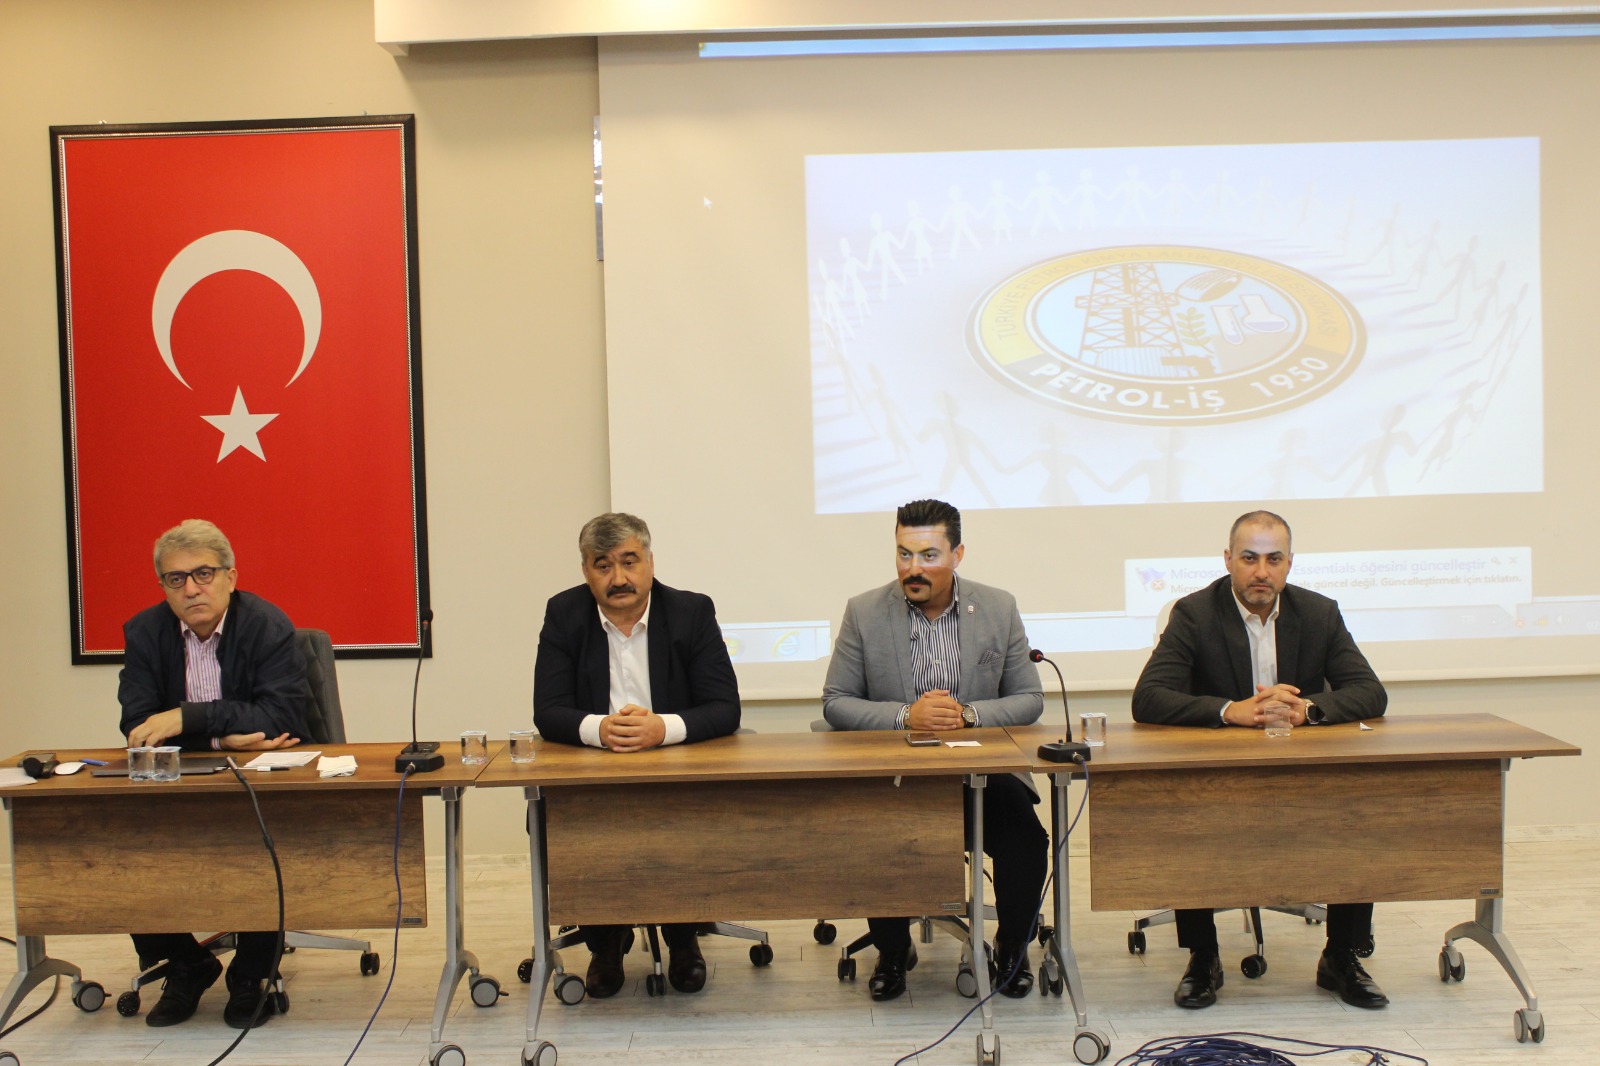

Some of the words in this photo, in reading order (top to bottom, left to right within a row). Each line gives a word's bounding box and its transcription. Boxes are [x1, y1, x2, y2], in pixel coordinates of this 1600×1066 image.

[1029, 363, 1225, 412] PETROL-İŞ
[1250, 357, 1329, 397] 1950
[1293, 561, 1356, 575] Essentials
[1359, 559, 1407, 576] öğesini
[1410, 557, 1487, 574] güncelleştir
[1314, 578, 1348, 590] güncel
[1351, 577, 1379, 589] değil.
[1381, 575, 1462, 588] Güncelleştirmek
[1464, 574, 1482, 587] için
